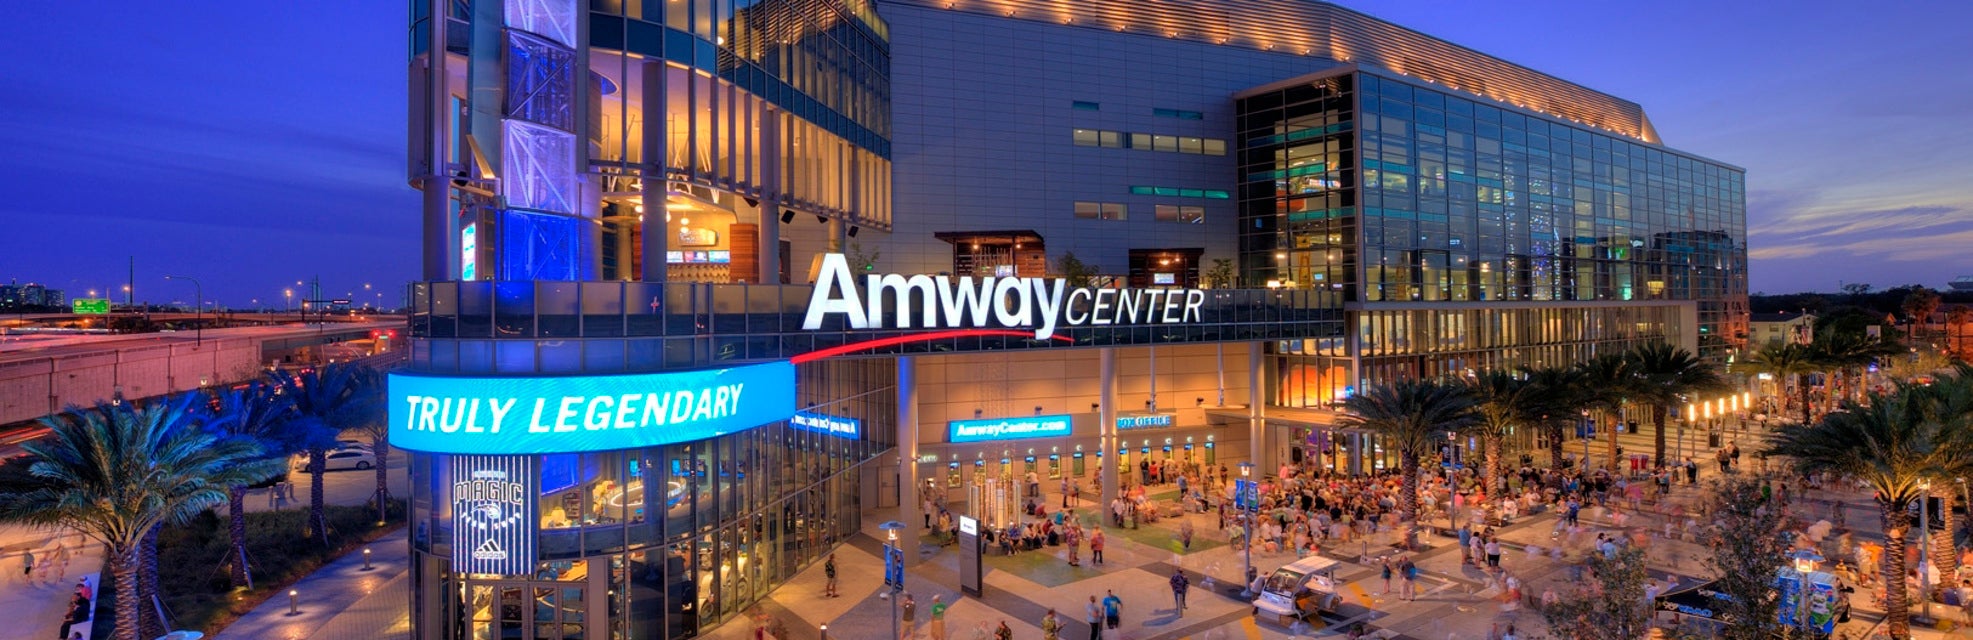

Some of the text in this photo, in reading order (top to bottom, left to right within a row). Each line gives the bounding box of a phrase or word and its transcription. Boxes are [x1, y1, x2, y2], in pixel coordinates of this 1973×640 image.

[802, 253, 1205, 340] Amway CENTER
[406, 395, 517, 433] TRULY
[528, 383, 743, 433] LEGENDARY
[454, 480, 523, 505] MAGIC
